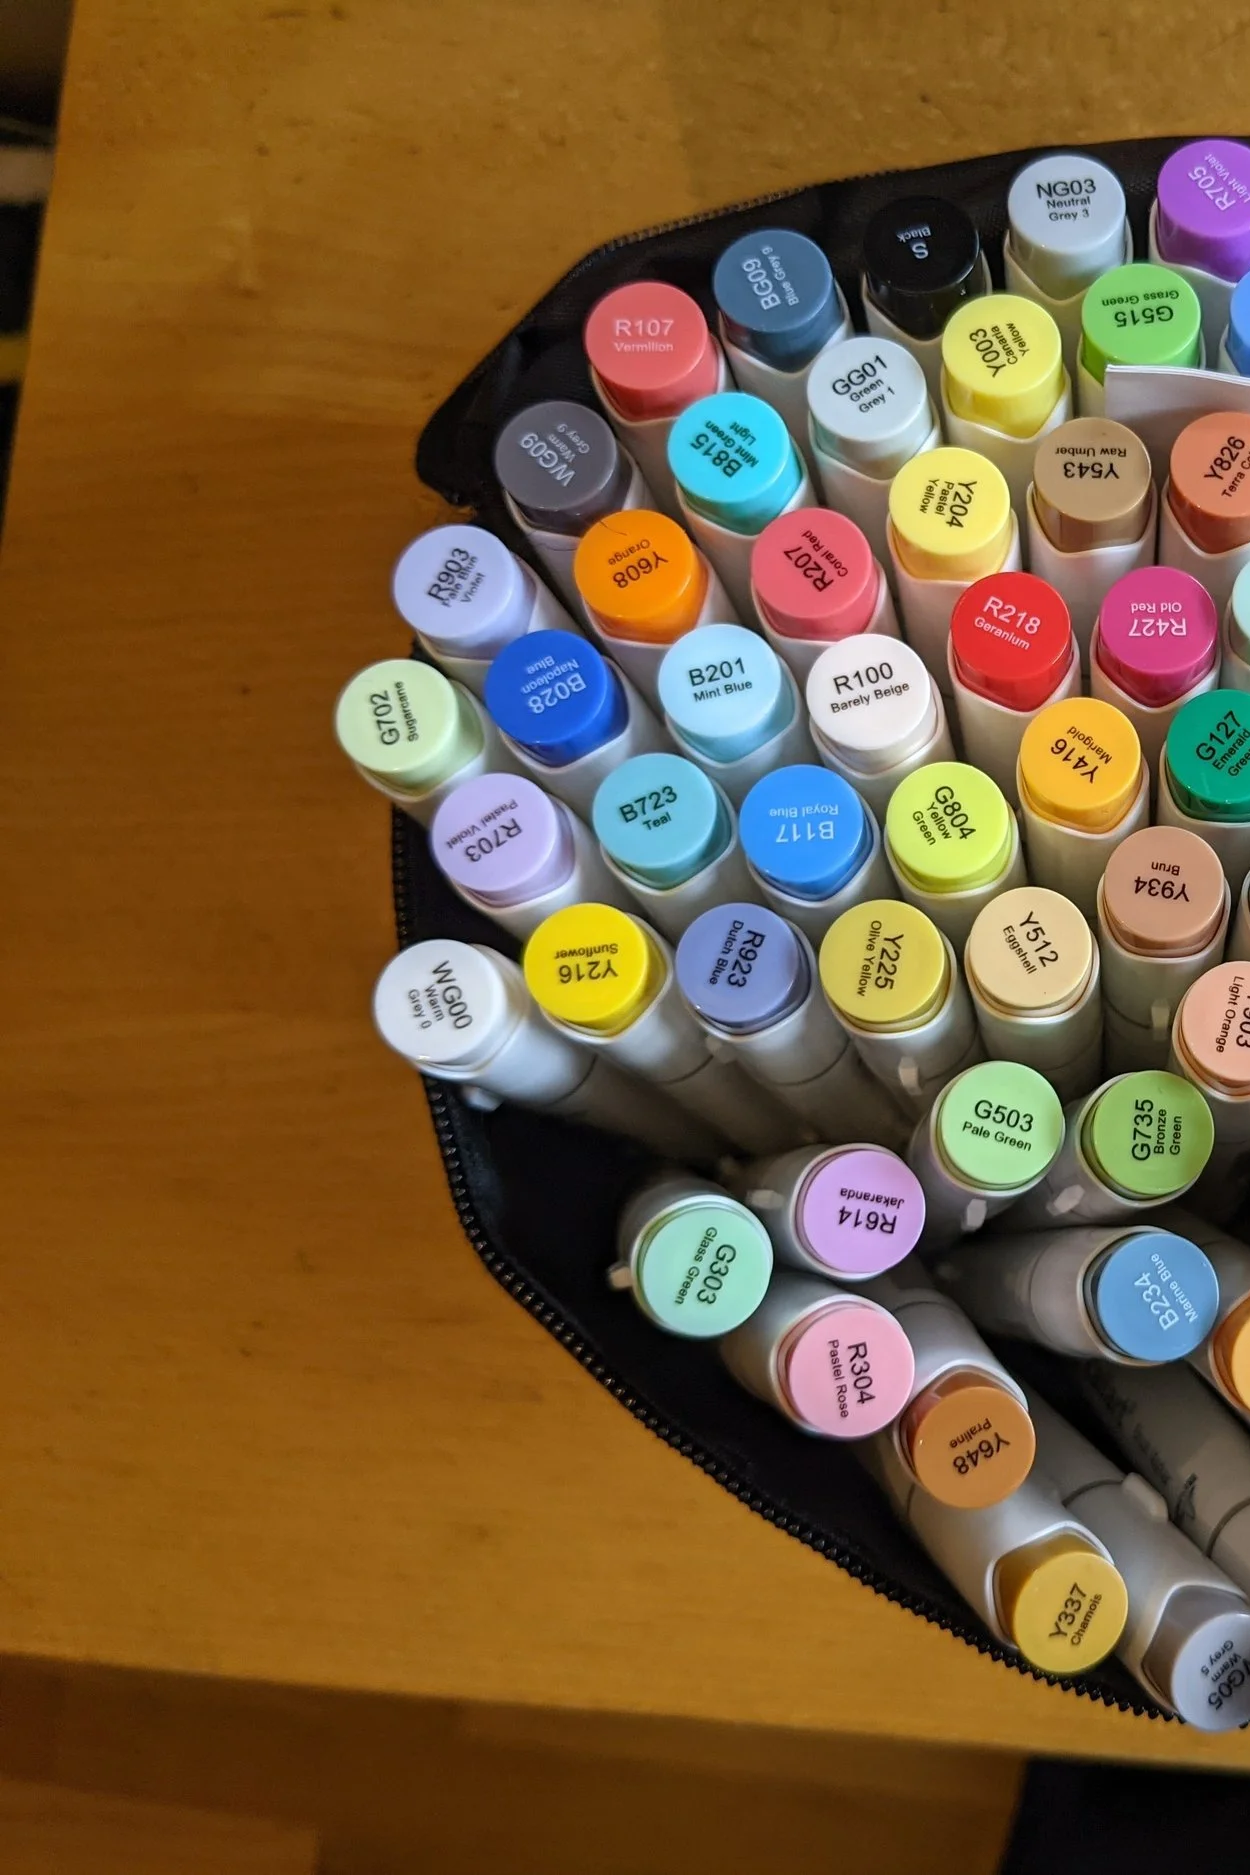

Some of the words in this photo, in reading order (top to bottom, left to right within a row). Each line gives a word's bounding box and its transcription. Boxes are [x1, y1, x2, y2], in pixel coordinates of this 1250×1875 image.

[1035, 177, 1097, 200] NG03
[1045, 195, 1091, 209] Neutral
[1187, 165, 1237, 211] R705
[896, 225, 932, 244] Black
[910, 240, 930, 260] S
[741, 257, 782, 311] BG09
[1101, 294, 1140, 307] Green
[1142, 289, 1180, 302] Grass
[614, 318, 675, 337] R107
[1113, 304, 1175, 329] G515
[613, 340, 674, 353] Vermilion
[968, 327, 1007, 379] Y003
[831, 354, 888, 396] GG01
[519, 431, 576, 487] WG09
[689, 432, 744, 479] B815
[1055, 446, 1096, 458] Umber
[1062, 461, 1120, 480] Y543
[1099, 447, 1127, 458] Raw
[1203, 435, 1246, 481] Y826
[1220, 470, 1246, 498] Terra
[945, 480, 978, 529] Y204
[607, 538, 651, 566] Orange
[801, 529, 825, 553] Red
[611, 550, 669, 589] Y608
[782, 545, 835, 593] R207
[820, 549, 849, 578] Coral
[973, 616, 1031, 650] Geranium
[982, 595, 1042, 635] R218
[1128, 617, 1187, 637] R427
[687, 656, 746, 688] B201
[832, 661, 894, 696] R100
[393, 681, 419, 743] Sugarcane
[527, 671, 587, 715] B028
[829, 694, 871, 714] Barely
[872, 682, 910, 700] Beige
[368, 689, 401, 747] G702
[1195, 709, 1242, 762] G127
[1049, 737, 1100, 784] Y416
[1066, 725, 1113, 765] Marigold
[618, 784, 678, 824] B723
[641, 811, 673, 831] Teal
[934, 785, 977, 840] G804
[463, 817, 523, 863] R703
[775, 820, 835, 844] B117
[1150, 861, 1181, 877] Brun
[1133, 875, 1190, 903] Y934
[554, 942, 619, 960] Sunflower
[1002, 924, 1038, 975] Eggshell
[1018, 910, 1060, 968] Y512
[557, 958, 619, 985] Y216
[726, 929, 767, 989] R923
[873, 933, 905, 990] Y225
[431, 960, 473, 1030] WG00
[973, 1099, 1035, 1133] G503
[1130, 1098, 1155, 1162] G735
[839, 1187, 906, 1210] Jakaranda
[837, 1205, 898, 1235] R614
[695, 1243, 737, 1306] G303
[1133, 1271, 1180, 1331] B234
[846, 1341, 876, 1405] R304
[948, 1417, 993, 1450] Praline
[952, 1431, 1011, 1476] Y648
[1047, 1581, 1087, 1639] Y337
[1069, 1593, 1103, 1647] Chamois
